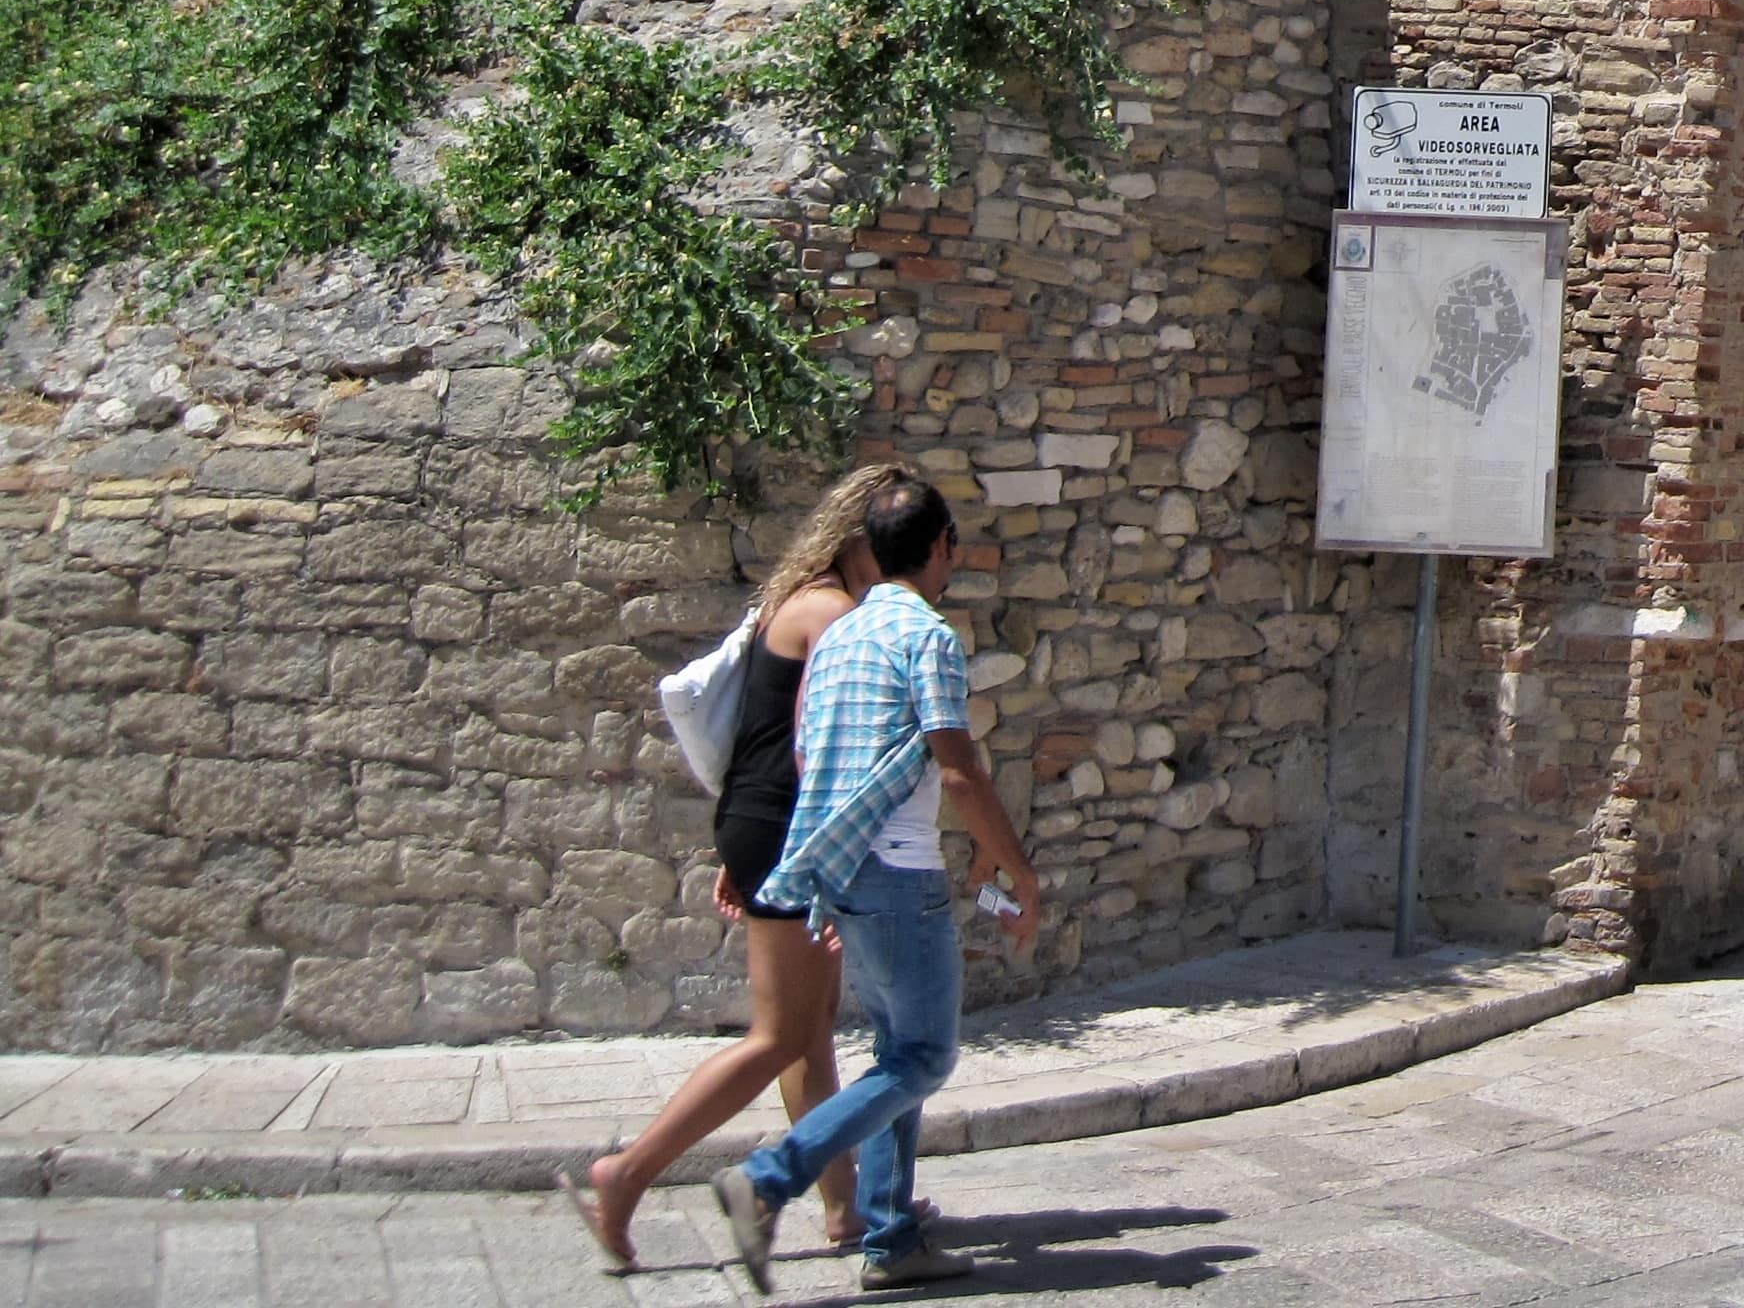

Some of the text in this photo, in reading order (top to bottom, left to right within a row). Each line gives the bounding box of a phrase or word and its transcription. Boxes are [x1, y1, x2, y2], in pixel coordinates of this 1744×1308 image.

[1489, 102, 1523, 110] Termoli
[1459, 116, 1500, 132] AREA
[1418, 140, 1540, 156] VIDEOSORVEGLIATA
